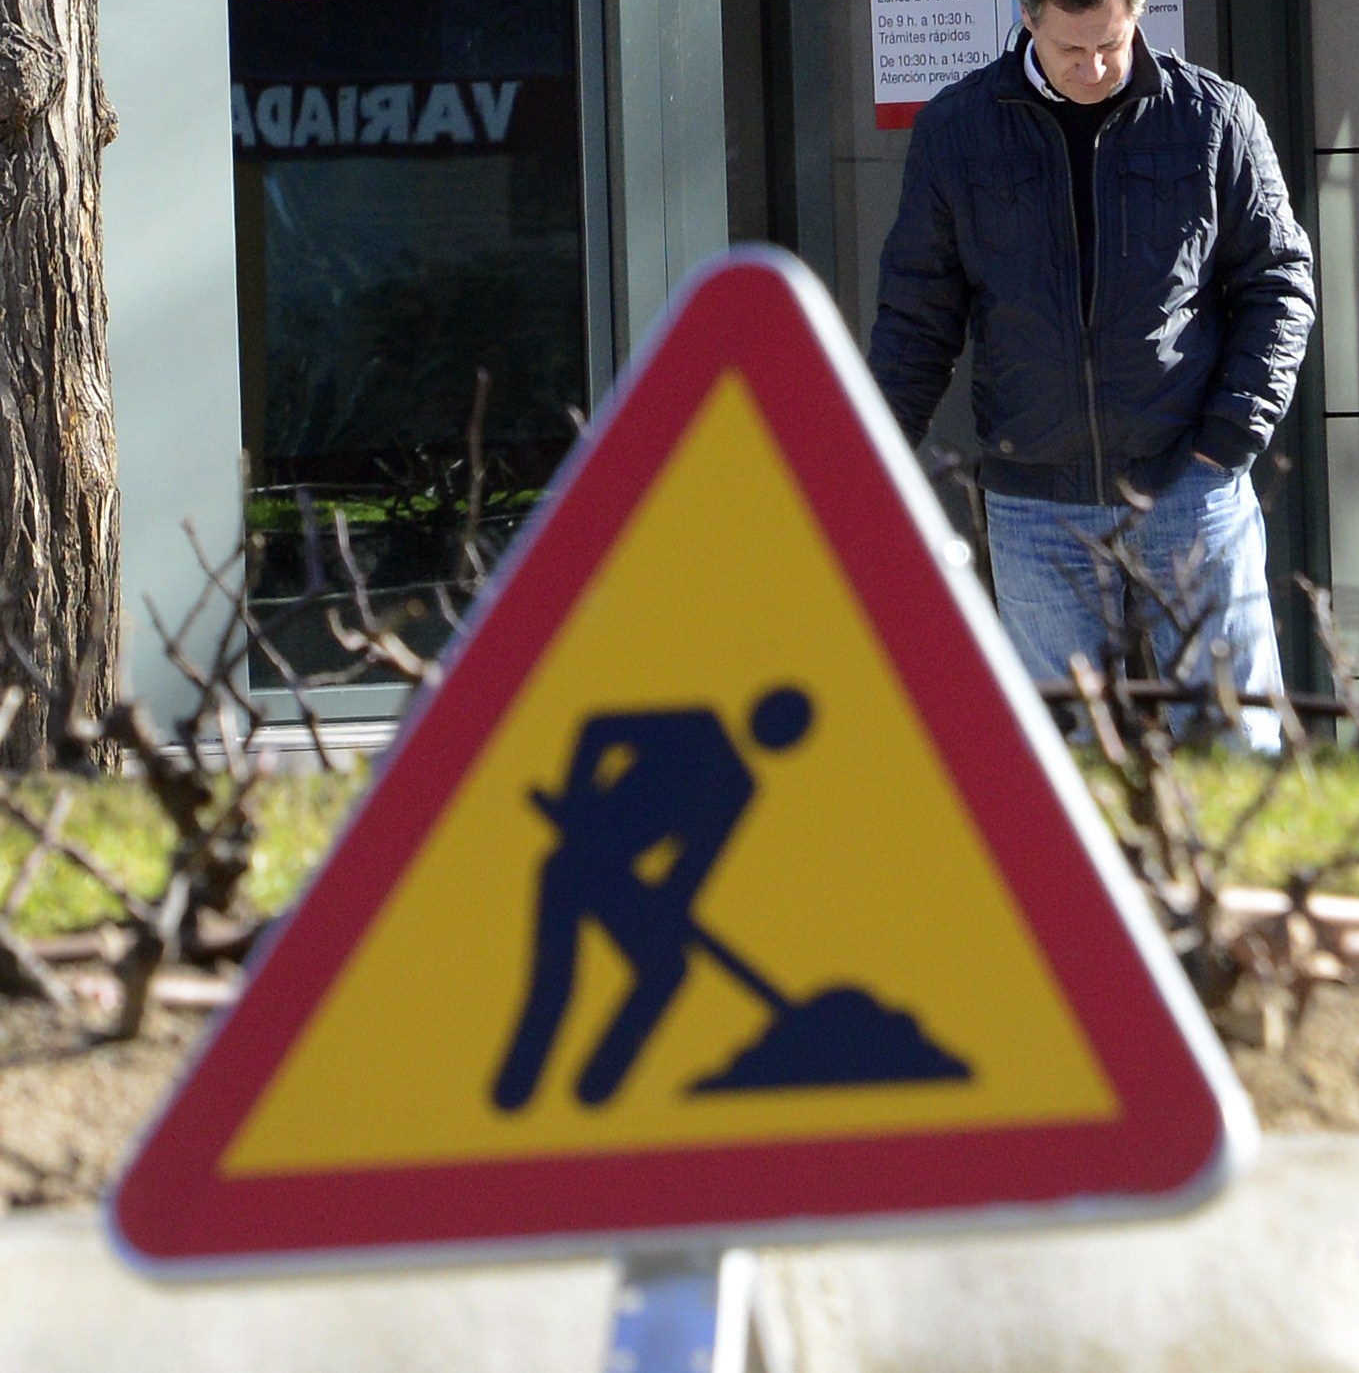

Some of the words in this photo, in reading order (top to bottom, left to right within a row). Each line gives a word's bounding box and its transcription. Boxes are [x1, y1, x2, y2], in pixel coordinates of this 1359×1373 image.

[1148, 4, 1178, 15] perros
[878, 15, 893, 28] De
[896, 15, 903, 27] 9
[907, 15, 917, 27] h.
[921, 16, 928, 26] a
[932, 13, 961, 26] 10:30
[965, 12, 975, 25] h.
[878, 31, 926, 44] Trámites
[929, 29, 971, 44] rápidos
[880, 55, 895, 68] De
[898, 54, 927, 67] 10:30
[929, 54, 938, 66] h.
[941, 56, 948, 65] a
[952, 52, 979, 65] 14:30
[880, 70, 926, 84] Atención
[929, 71, 960, 84] previa
